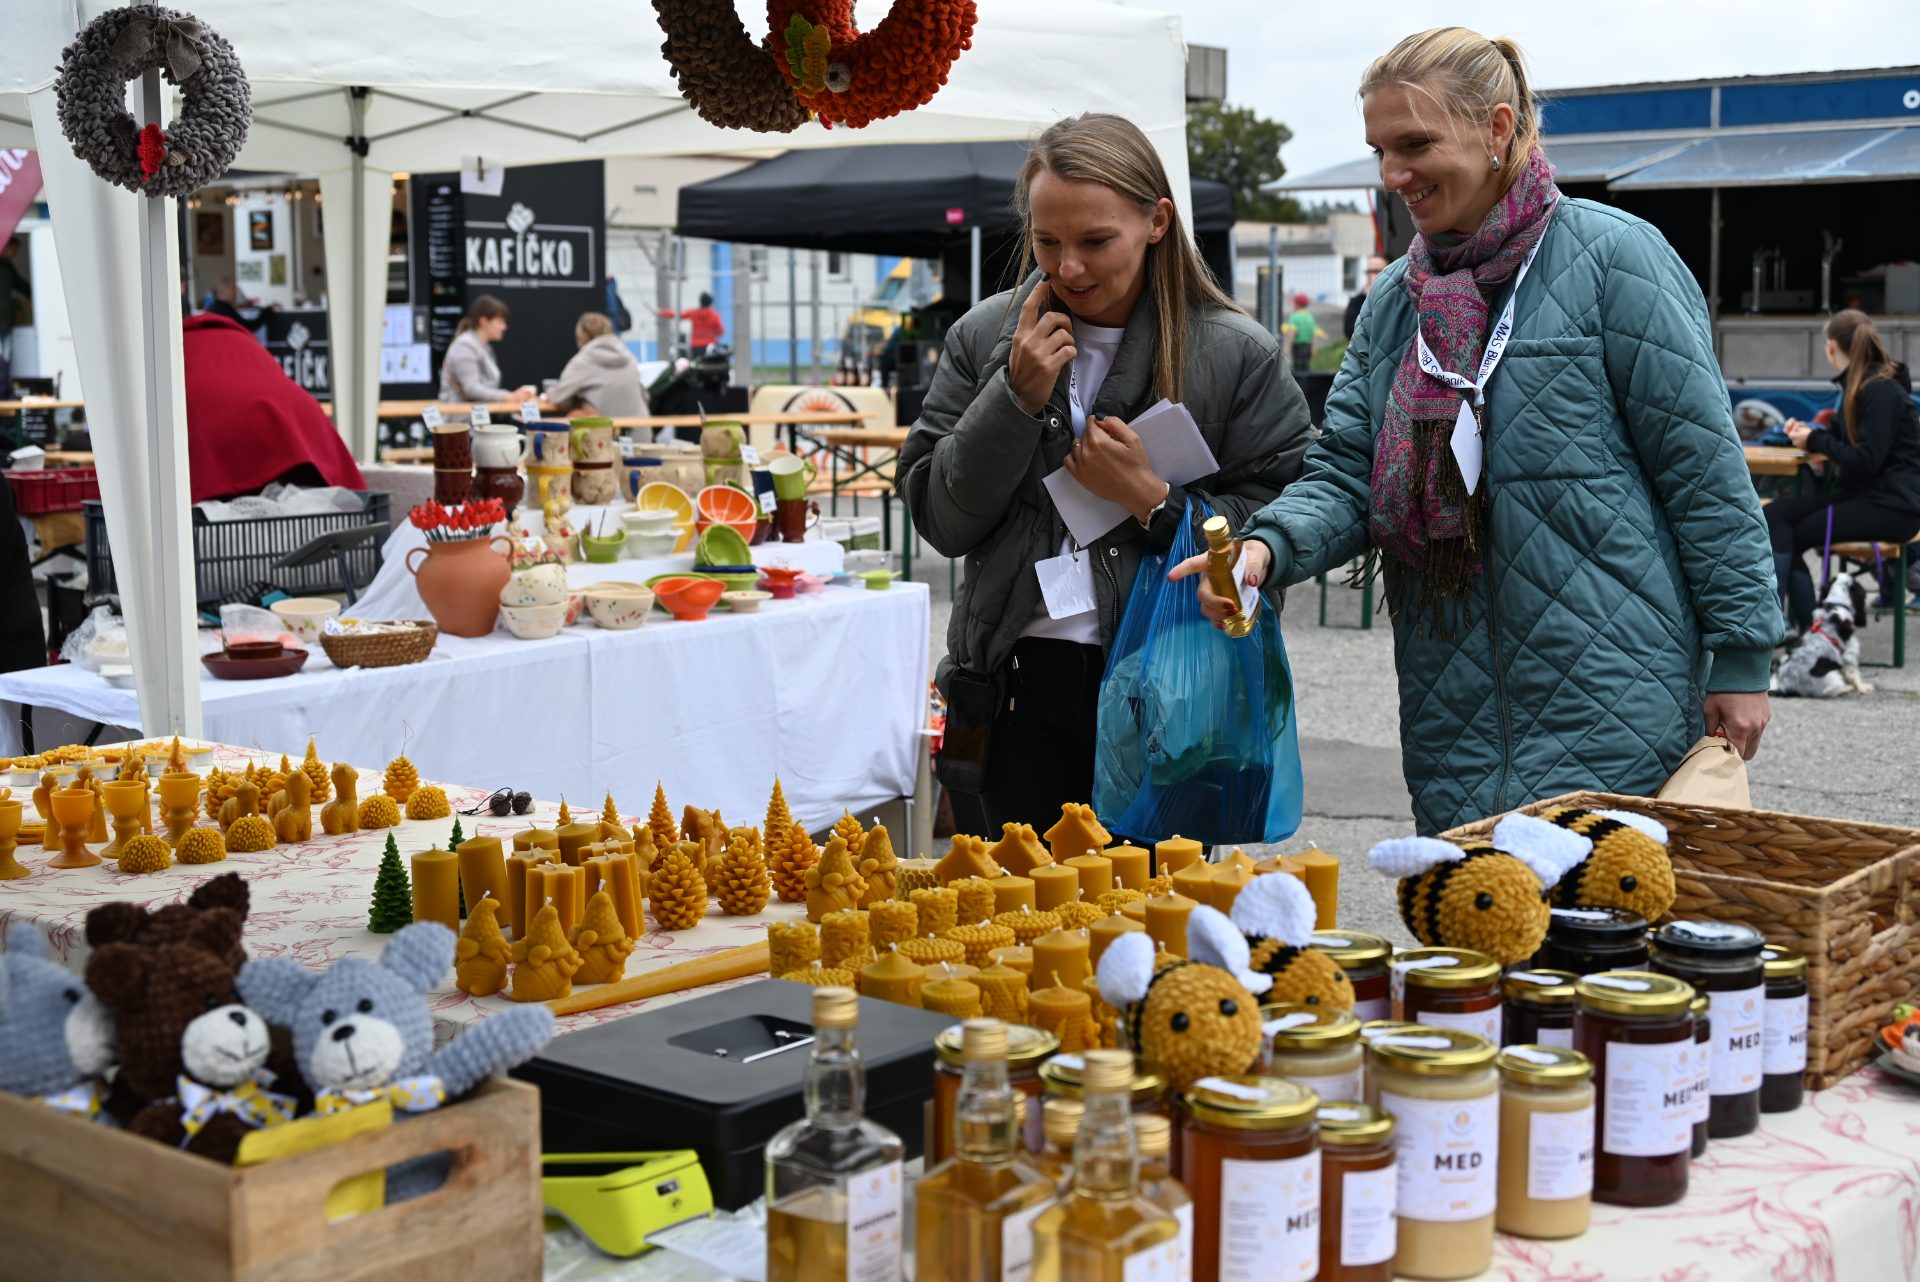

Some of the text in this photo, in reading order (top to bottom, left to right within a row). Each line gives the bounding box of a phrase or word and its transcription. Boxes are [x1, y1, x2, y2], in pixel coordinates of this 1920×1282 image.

[1492, 323, 1510, 349] MAS
[1729, 1032, 1760, 1051] MED
[1788, 1031, 1806, 1046] ME
[1663, 1087, 1691, 1109] MED
[1434, 1152, 1482, 1171] MED
